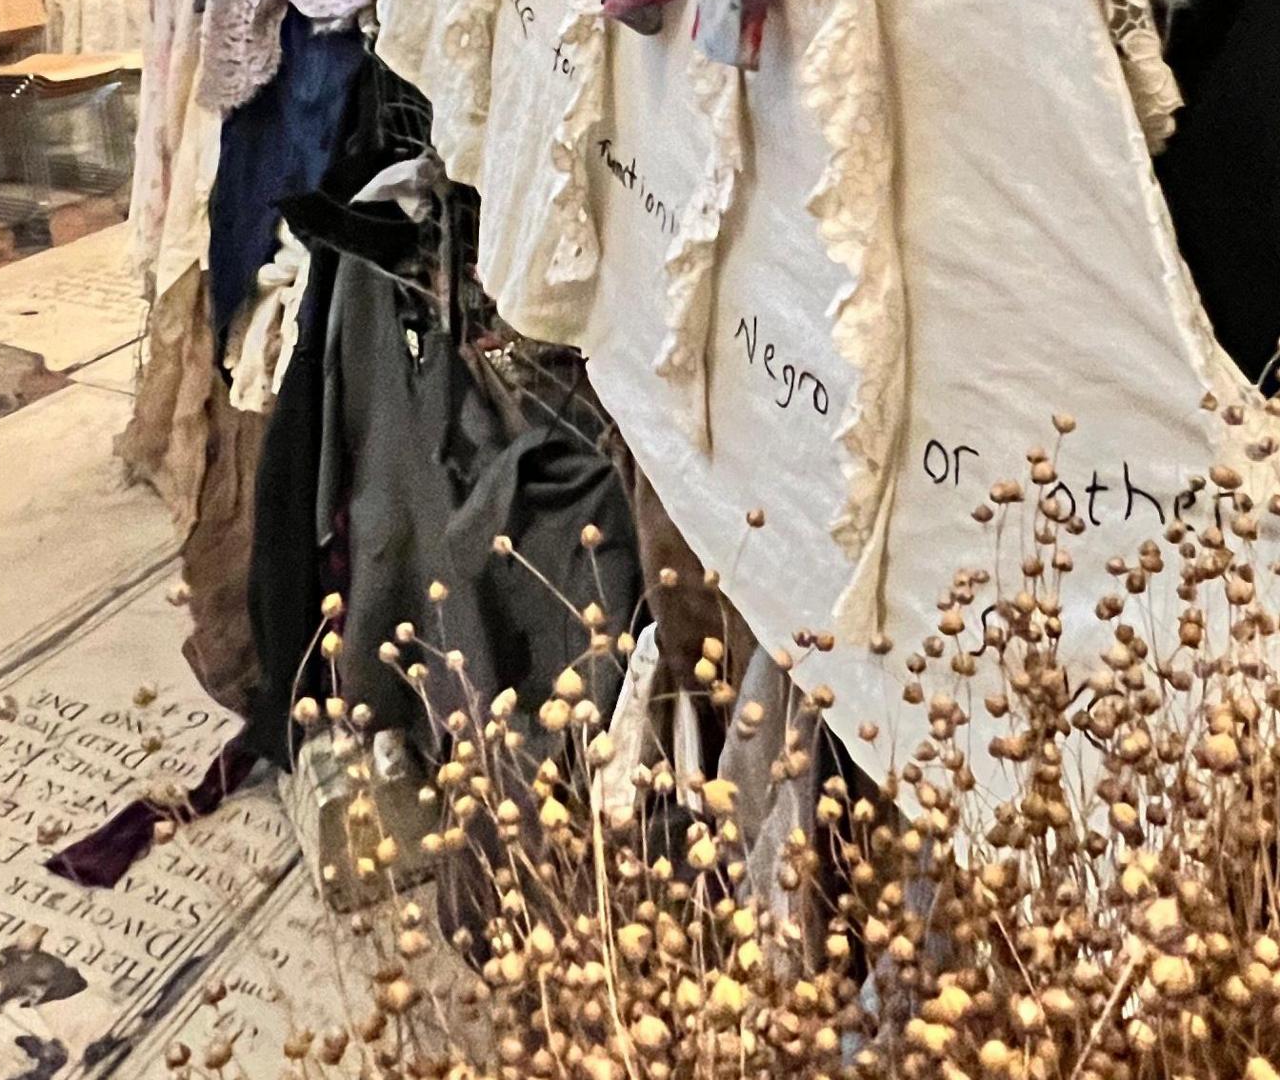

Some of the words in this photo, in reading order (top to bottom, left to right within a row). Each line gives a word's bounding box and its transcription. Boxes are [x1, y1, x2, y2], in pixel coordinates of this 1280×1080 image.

[735, 317, 829, 415] Negro
[923, 439, 980, 486] or
[1038, 462, 1242, 530] other
[42, 933, 156, 1000] HERE
